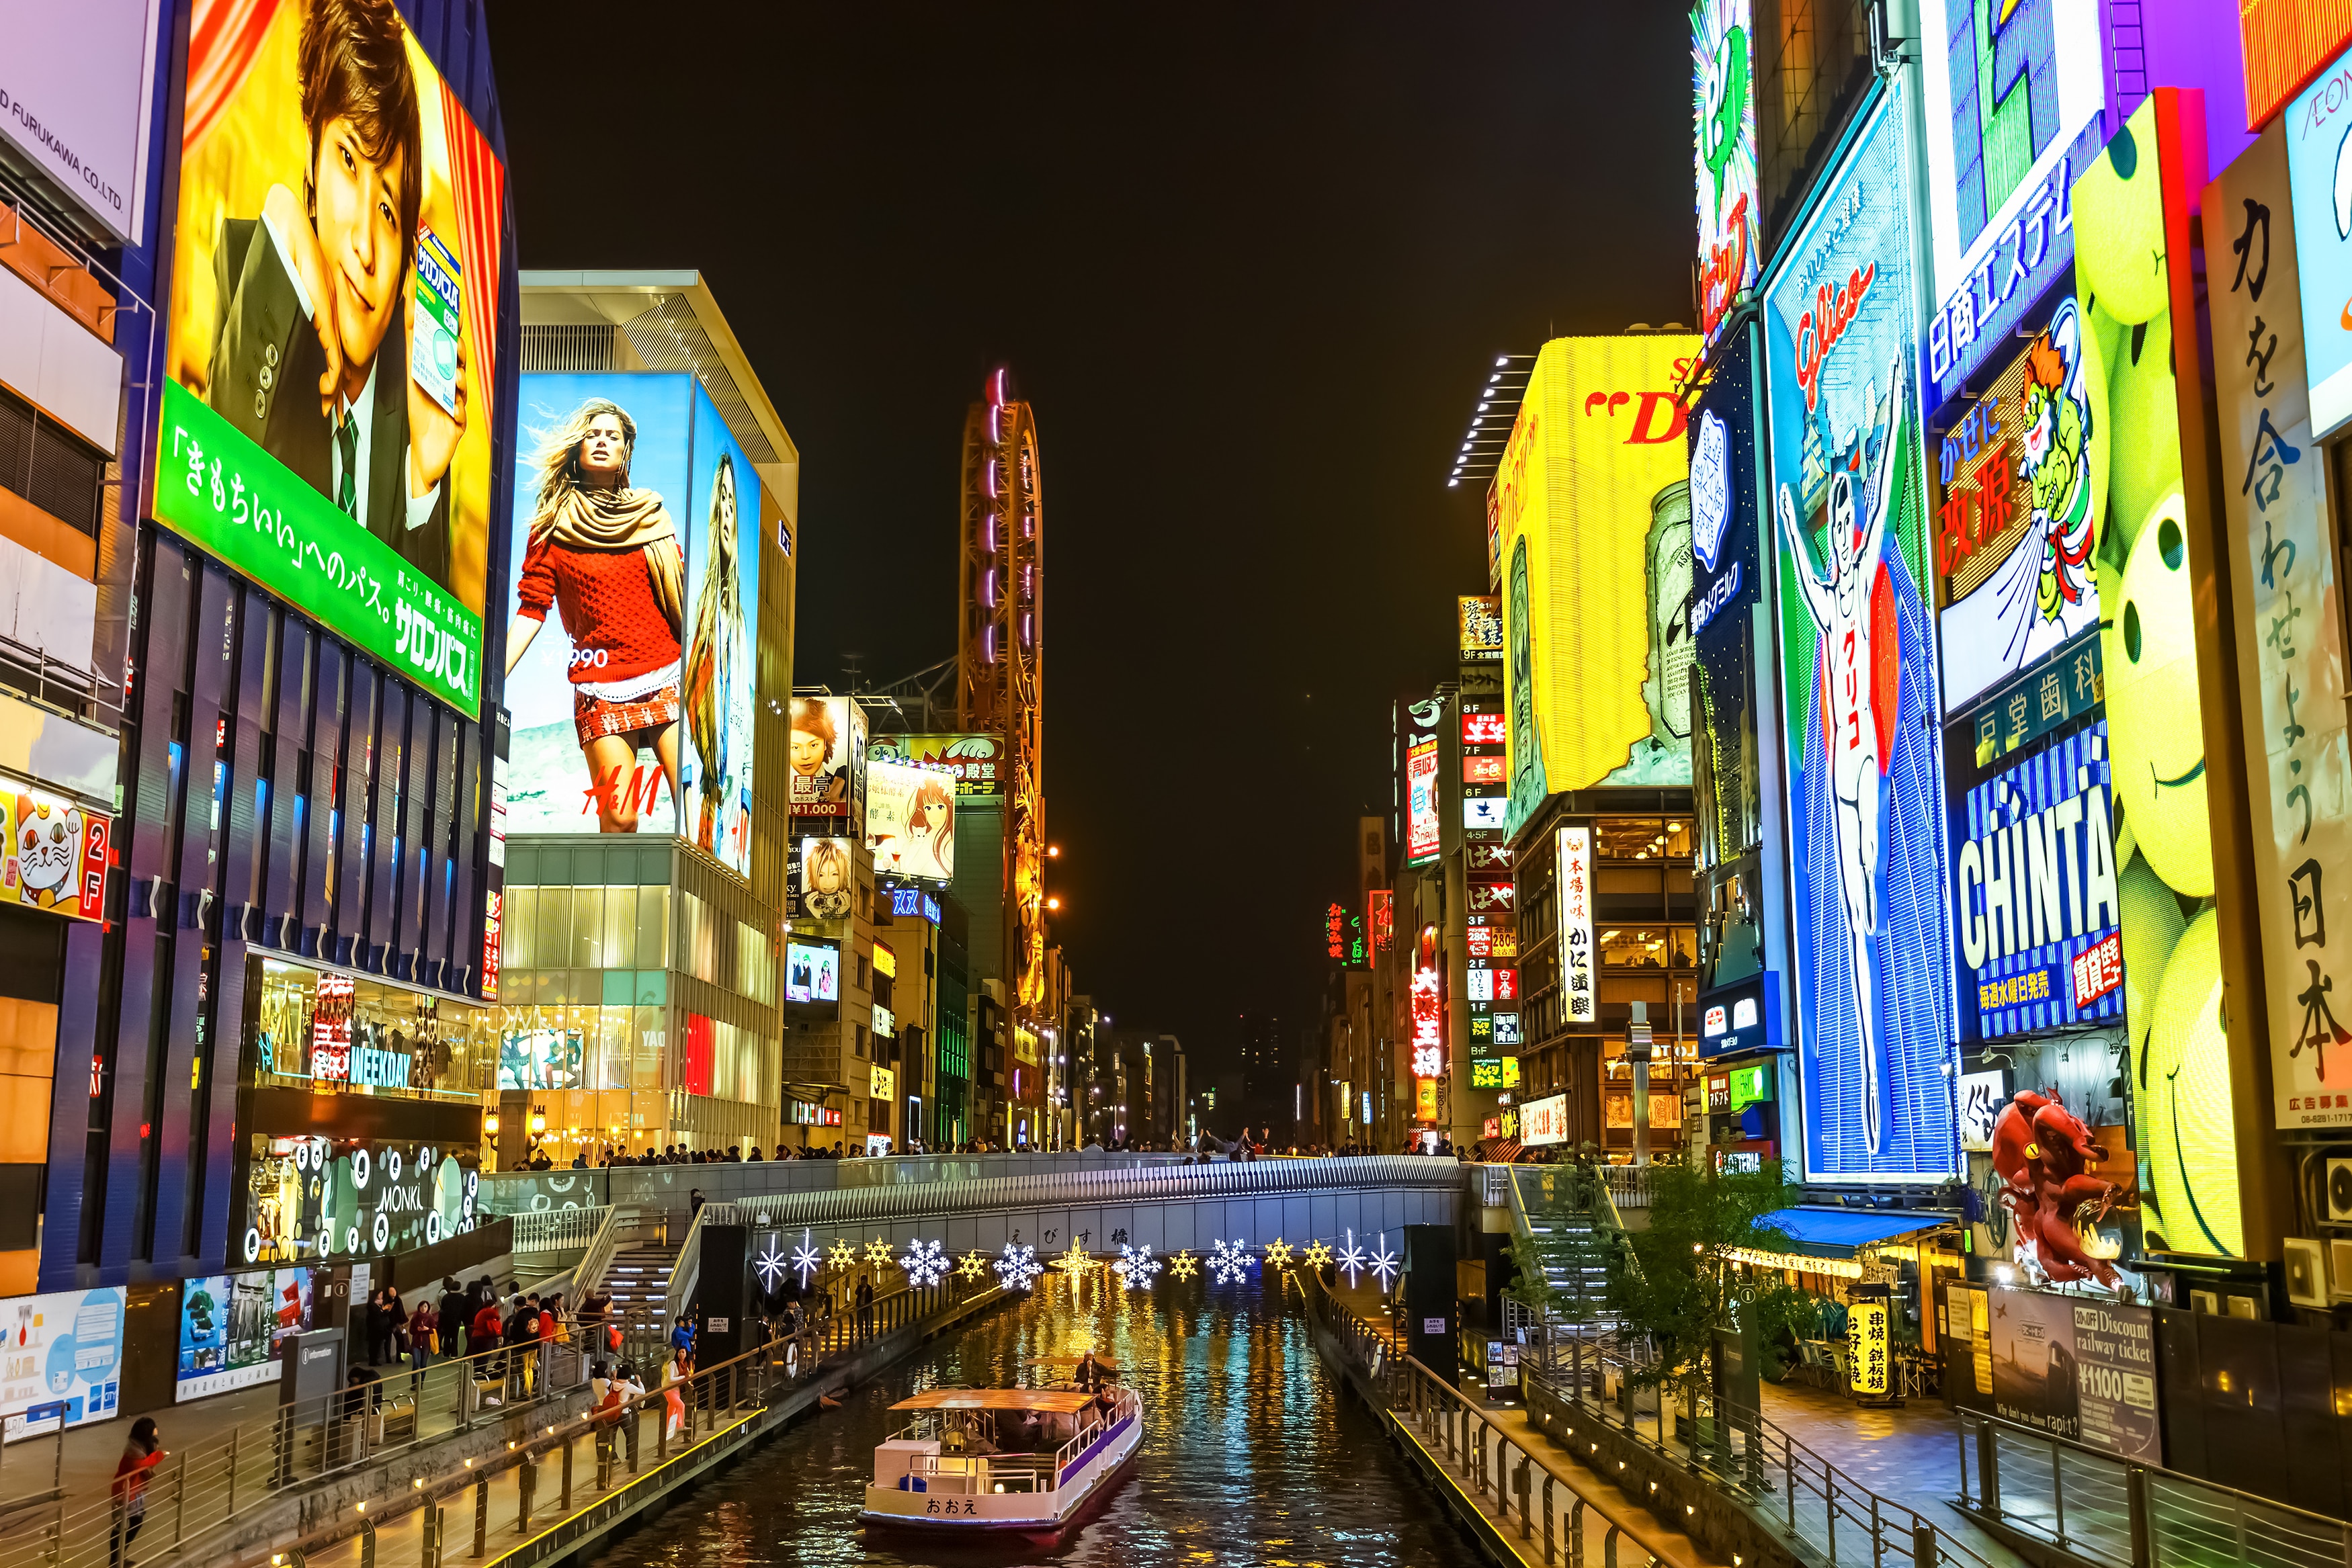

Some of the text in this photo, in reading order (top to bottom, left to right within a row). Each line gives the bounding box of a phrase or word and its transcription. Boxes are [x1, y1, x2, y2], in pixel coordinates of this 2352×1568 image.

[12, 103, 81, 175] FURUKAWA
[1795, 261, 1876, 415] Glico
[1939, 396, 2001, 485] かぜに
[1936, 440, 2013, 578] 改源
[397, 569, 476, 640] 肩こり・腰痛・筋肉痛に
[1691, 561, 1738, 636] 雪印メグミルク
[395, 596, 466, 697] サロンパス
[540, 648, 608, 668] ¥1990
[1464, 650, 1476, 660] 9F
[1843, 619, 1860, 750] グリコ
[1463, 705, 1480, 713] 8F
[1464, 746, 1480, 754] 7F
[582, 764, 664, 818] H&M
[794, 775, 831, 794] 最高
[1465, 788, 1481, 797] 6F
[789, 804, 837, 815] ¥1,000
[84, 823, 106, 909] 2F
[1468, 884, 1515, 910] はや
[1568, 858, 1585, 920] 本場の味
[1329, 903, 1343, 958] お好み焼
[1468, 916, 1485, 925] 3F
[491, 894, 501, 988] インターネット
[1493, 934, 1516, 947] 280円
[483, 932, 492, 986] コミック
[1468, 959, 1486, 969] 2F
[1498, 969, 1513, 1000] 白木屋
[1980, 970, 2050, 1010] 毎週水曜日発売
[2073, 947, 2105, 1005] 賃貸
[1470, 1002, 1486, 1012] 1F
[1471, 1046, 1487, 1055] B1F
[1496, 1031, 1517, 1043] 青山
[349, 1046, 412, 1088] WEEKDAY
[1472, 1075, 1501, 1086] ドンキー
[1474, 1064, 1499, 1076] びっくり
[2289, 1095, 2349, 1110] 広告募集
[1011, 1228, 1129, 1245] えびす橋
[2099, 1311, 2149, 1340] Discount
[1848, 1317, 1861, 1384] お好み焼
[1868, 1311, 1885, 1389] 串焼・鉄板焼
[2076, 1332, 2151, 1362] railway ticket
[2078, 1362, 2122, 1402] ¥1,100
[1997, 1403, 2007, 1418] Why
[2021, 1413, 2029, 1424] you
[927, 1498, 977, 1515] おおえ
